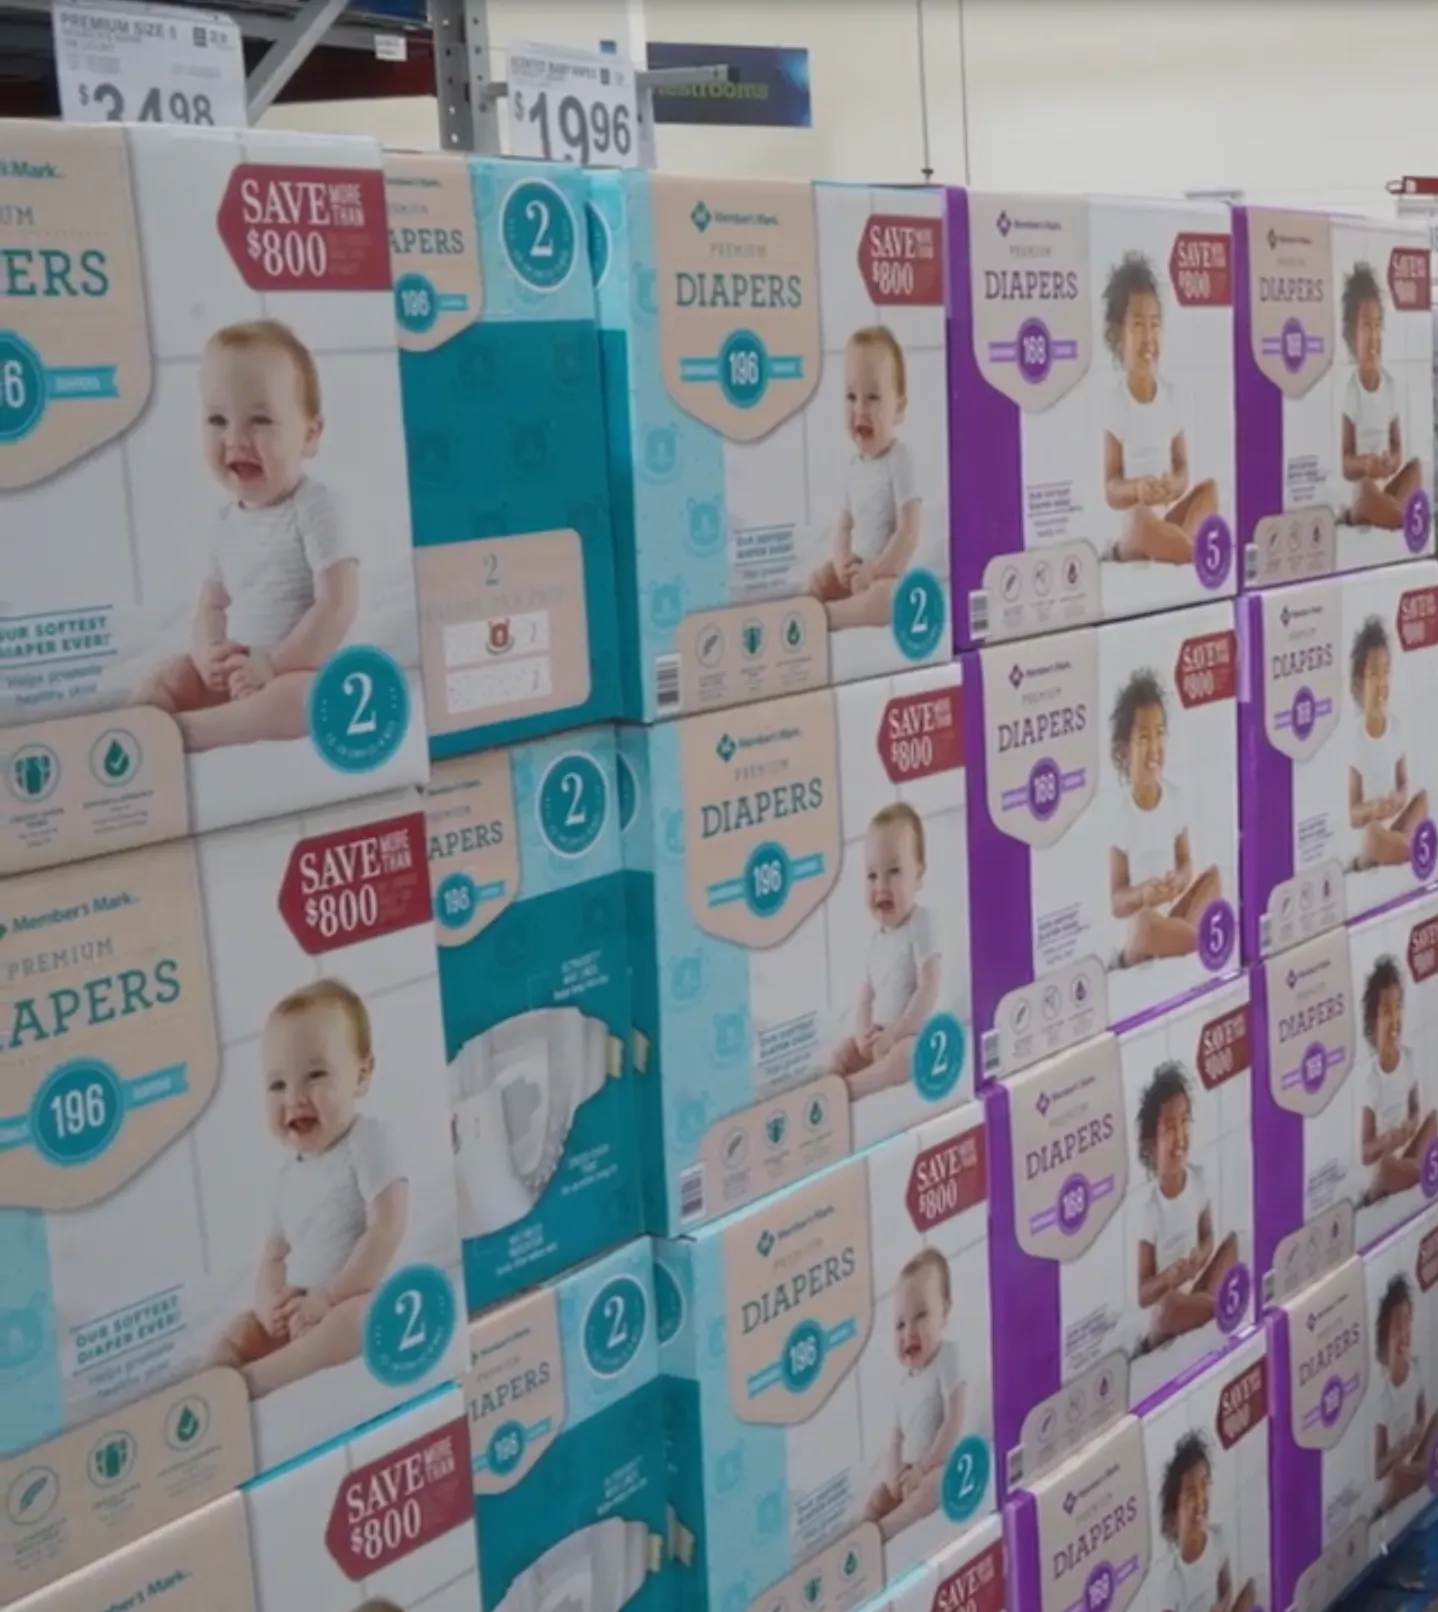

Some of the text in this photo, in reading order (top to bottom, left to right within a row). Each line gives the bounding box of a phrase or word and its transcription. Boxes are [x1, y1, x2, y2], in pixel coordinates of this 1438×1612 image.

[60, 12, 130, 33] PREMIUM
[132, 22, 165, 38] SIZE
[240, 177, 331, 227] SAVE
[328, 183, 363, 207] MORE
[331, 204, 365, 228] THAN
[525, 199, 553, 258] 2
[246, 229, 328, 278] $800
[869, 225, 916, 260] SAVE
[675, 272, 802, 308] DIAPERS
[872, 260, 914, 295] $800
[984, 269, 1079, 301] DIAPERS
[729, 352, 759, 386] 196
[1410, 502, 1423, 536] 5
[482, 553, 500, 587] 2
[1205, 531, 1220, 570] 5
[32, 615, 108, 638] SOFTEST
[909, 586, 928, 634] 2
[1271, 643, 1334, 681] DIAPERS
[342, 671, 377, 736] 2
[887, 701, 936, 740] SAVE
[997, 703, 1088, 754] DIAPERS
[891, 735, 934, 773] $800
[560, 772, 587, 827] 2
[701, 776, 824, 839] DIAPERS
[379, 829, 410, 853] MORE
[381, 847, 414, 873] THAN
[1421, 830, 1431, 864] 5
[299, 835, 381, 896] SAVE
[753, 859, 782, 897] 196
[11, 903, 91, 933] Member's
[305, 885, 378, 938] $800
[1210, 912, 1224, 960] 5
[7, 936, 115, 980] PREMIUM
[1277, 992, 1346, 1044] DIAPERS
[929, 1029, 948, 1076] 2
[50, 1083, 107, 1141] 196
[1025, 1112, 1115, 1181] DIAPERS
[1429, 1150, 1438, 1179] 5
[915, 1149, 963, 1191] SAVE
[918, 1180, 959, 1220] $800
[740, 1245, 857, 1336] DIAPERS
[1227, 1277, 1240, 1315] 5
[76, 1295, 180, 1349] OUR SOFTEST
[393, 1288, 426, 1353] 2
[603, 1295, 628, 1349] 2
[77, 1334, 136, 1365] DIAPER
[1299, 1322, 1361, 1388] DIAPERS
[424, 1436, 453, 1467] MORE
[425, 1455, 456, 1485] THAN
[345, 1455, 425, 1525] SAVE
[956, 1453, 974, 1499] 2
[349, 1498, 422, 1561] $800
[1051, 1495, 1138, 1581] DIAPERS
